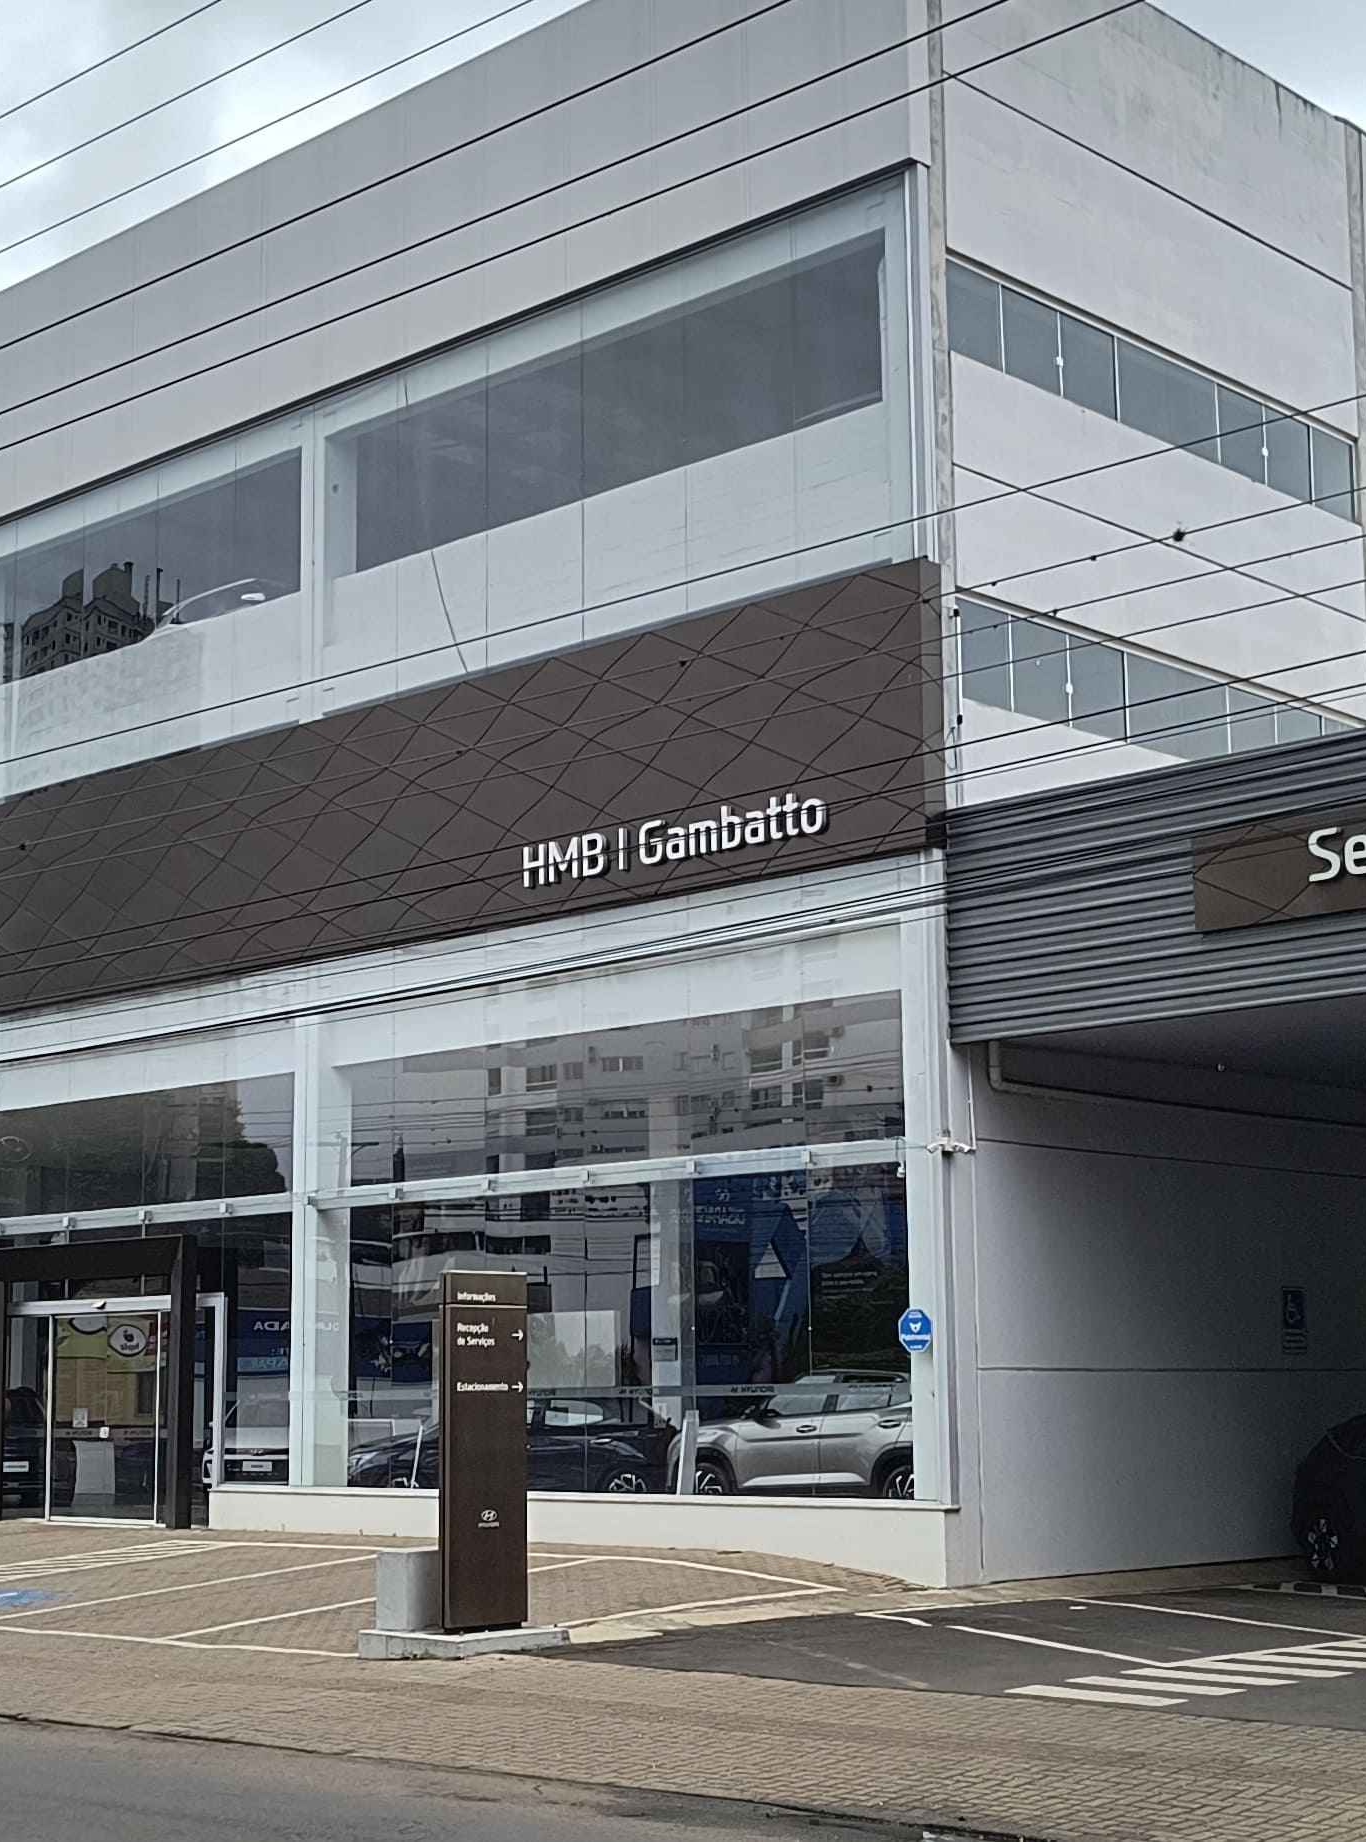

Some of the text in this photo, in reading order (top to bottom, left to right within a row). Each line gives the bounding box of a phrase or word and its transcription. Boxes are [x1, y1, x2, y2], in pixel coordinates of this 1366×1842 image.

[521, 831, 609, 889] HMB
[638, 792, 829, 866] Gambatto
[457, 1291, 496, 1303] Informações
[457, 1322, 489, 1334] Recepção
[457, 1336, 495, 1348] de Serviços
[456, 1381, 509, 1392] Estacionamento
